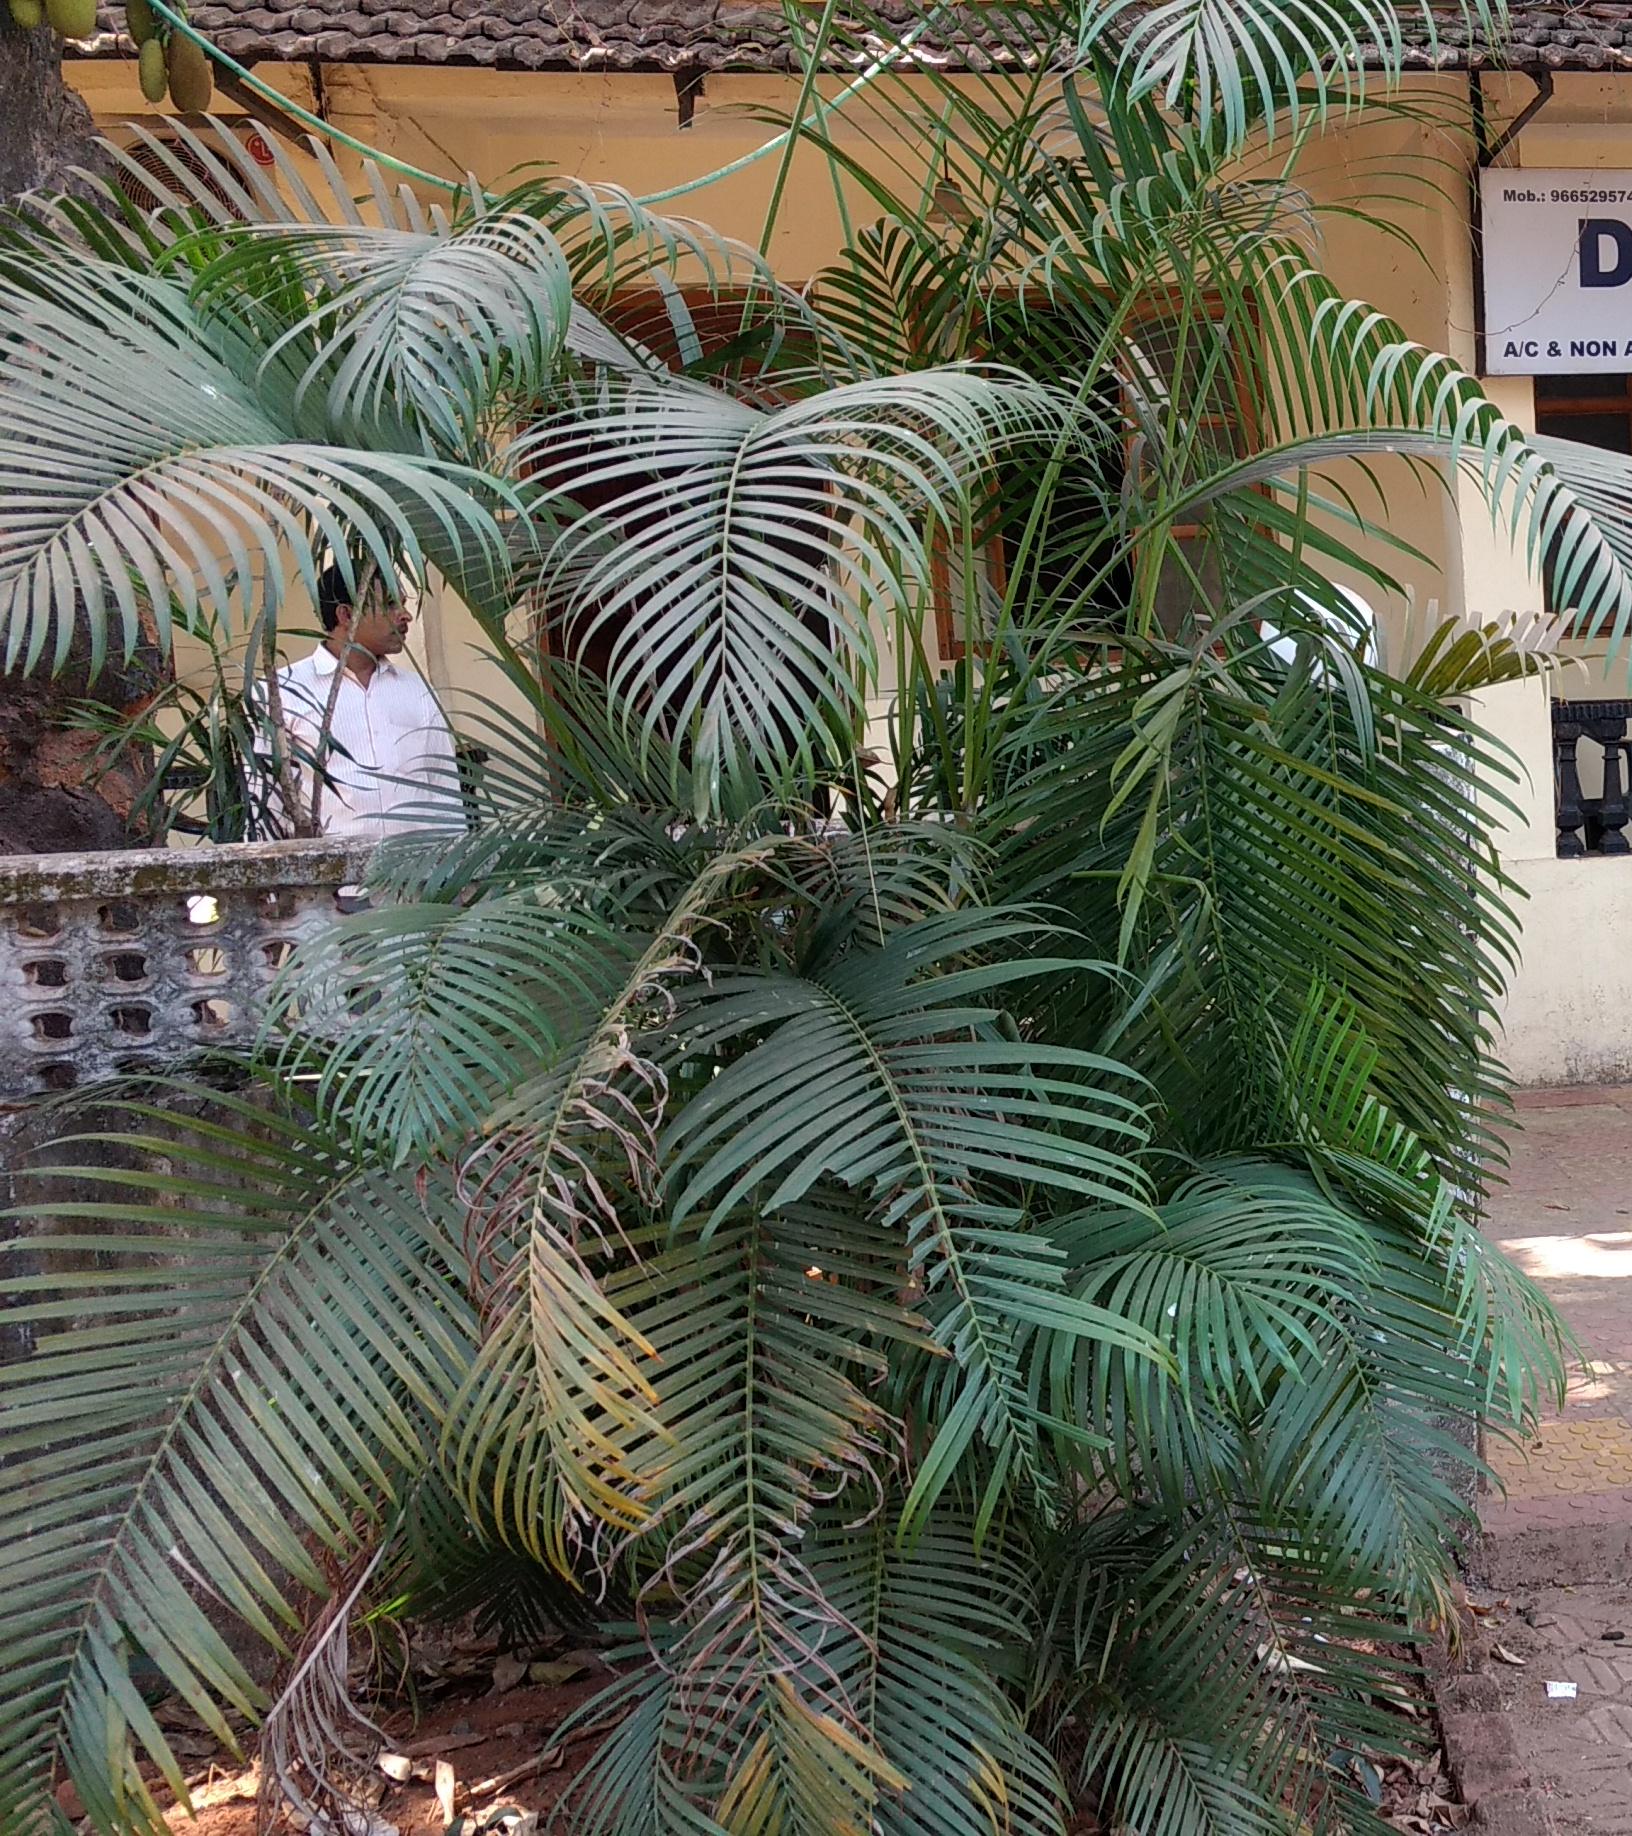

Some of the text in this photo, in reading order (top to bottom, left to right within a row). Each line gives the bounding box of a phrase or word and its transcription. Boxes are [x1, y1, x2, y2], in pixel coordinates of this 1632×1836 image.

[1503, 190, 1546, 203] Mob.:
[1503, 341, 1539, 358] A/C
[1547, 341, 1562, 357] &
[1570, 341, 1616, 356] NON
